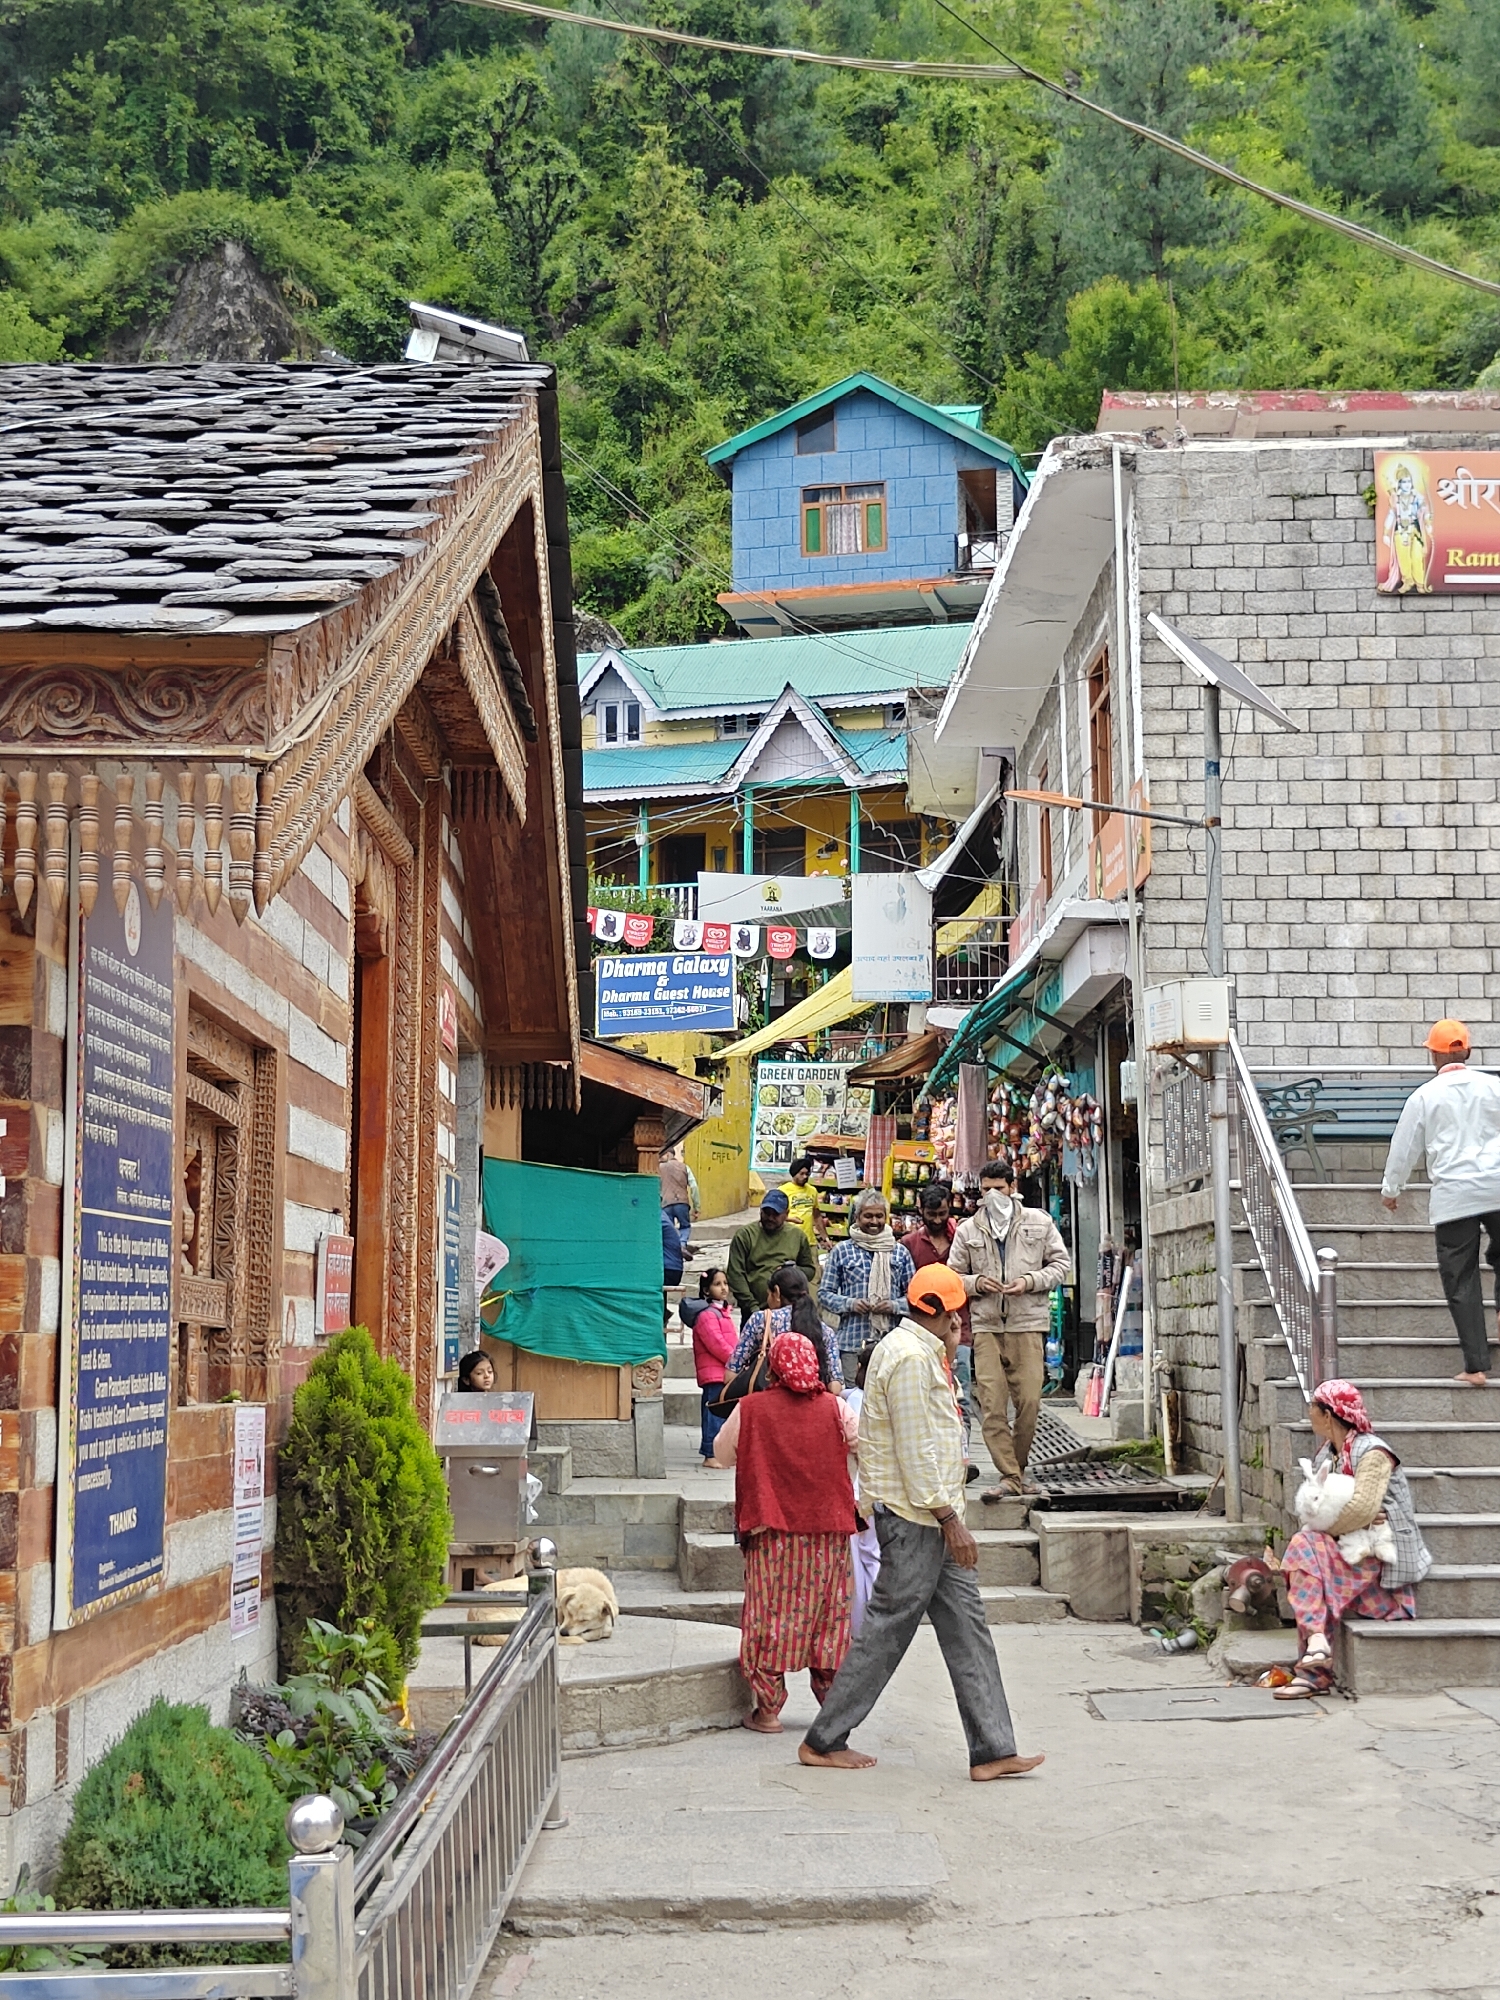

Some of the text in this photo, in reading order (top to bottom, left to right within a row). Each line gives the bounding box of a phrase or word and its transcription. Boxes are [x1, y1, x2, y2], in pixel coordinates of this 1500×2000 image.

[602, 956, 730, 979] Dharma Galaxy
[656, 975, 670, 987] &
[601, 985, 731, 1004] Dharma Guest House
[760, 1067, 841, 1081] GREEN GARDEN
[98, 1231, 107, 1252] This
[108, 1232, 113, 1253] is
[120, 1295, 128, 1311] are
[82, 1319, 90, 1340] this
[91, 1319, 95, 1340] is
[138, 1318, 148, 1343] keep
[155, 1318, 167, 1342] place
[81, 1350, 92, 1371] neat
[93, 1348, 97, 1370] &
[150, 1372, 153, 1392] &
[445, 1409, 526, 1424] दान पात्र
[109, 1507, 137, 1536] THANKS
